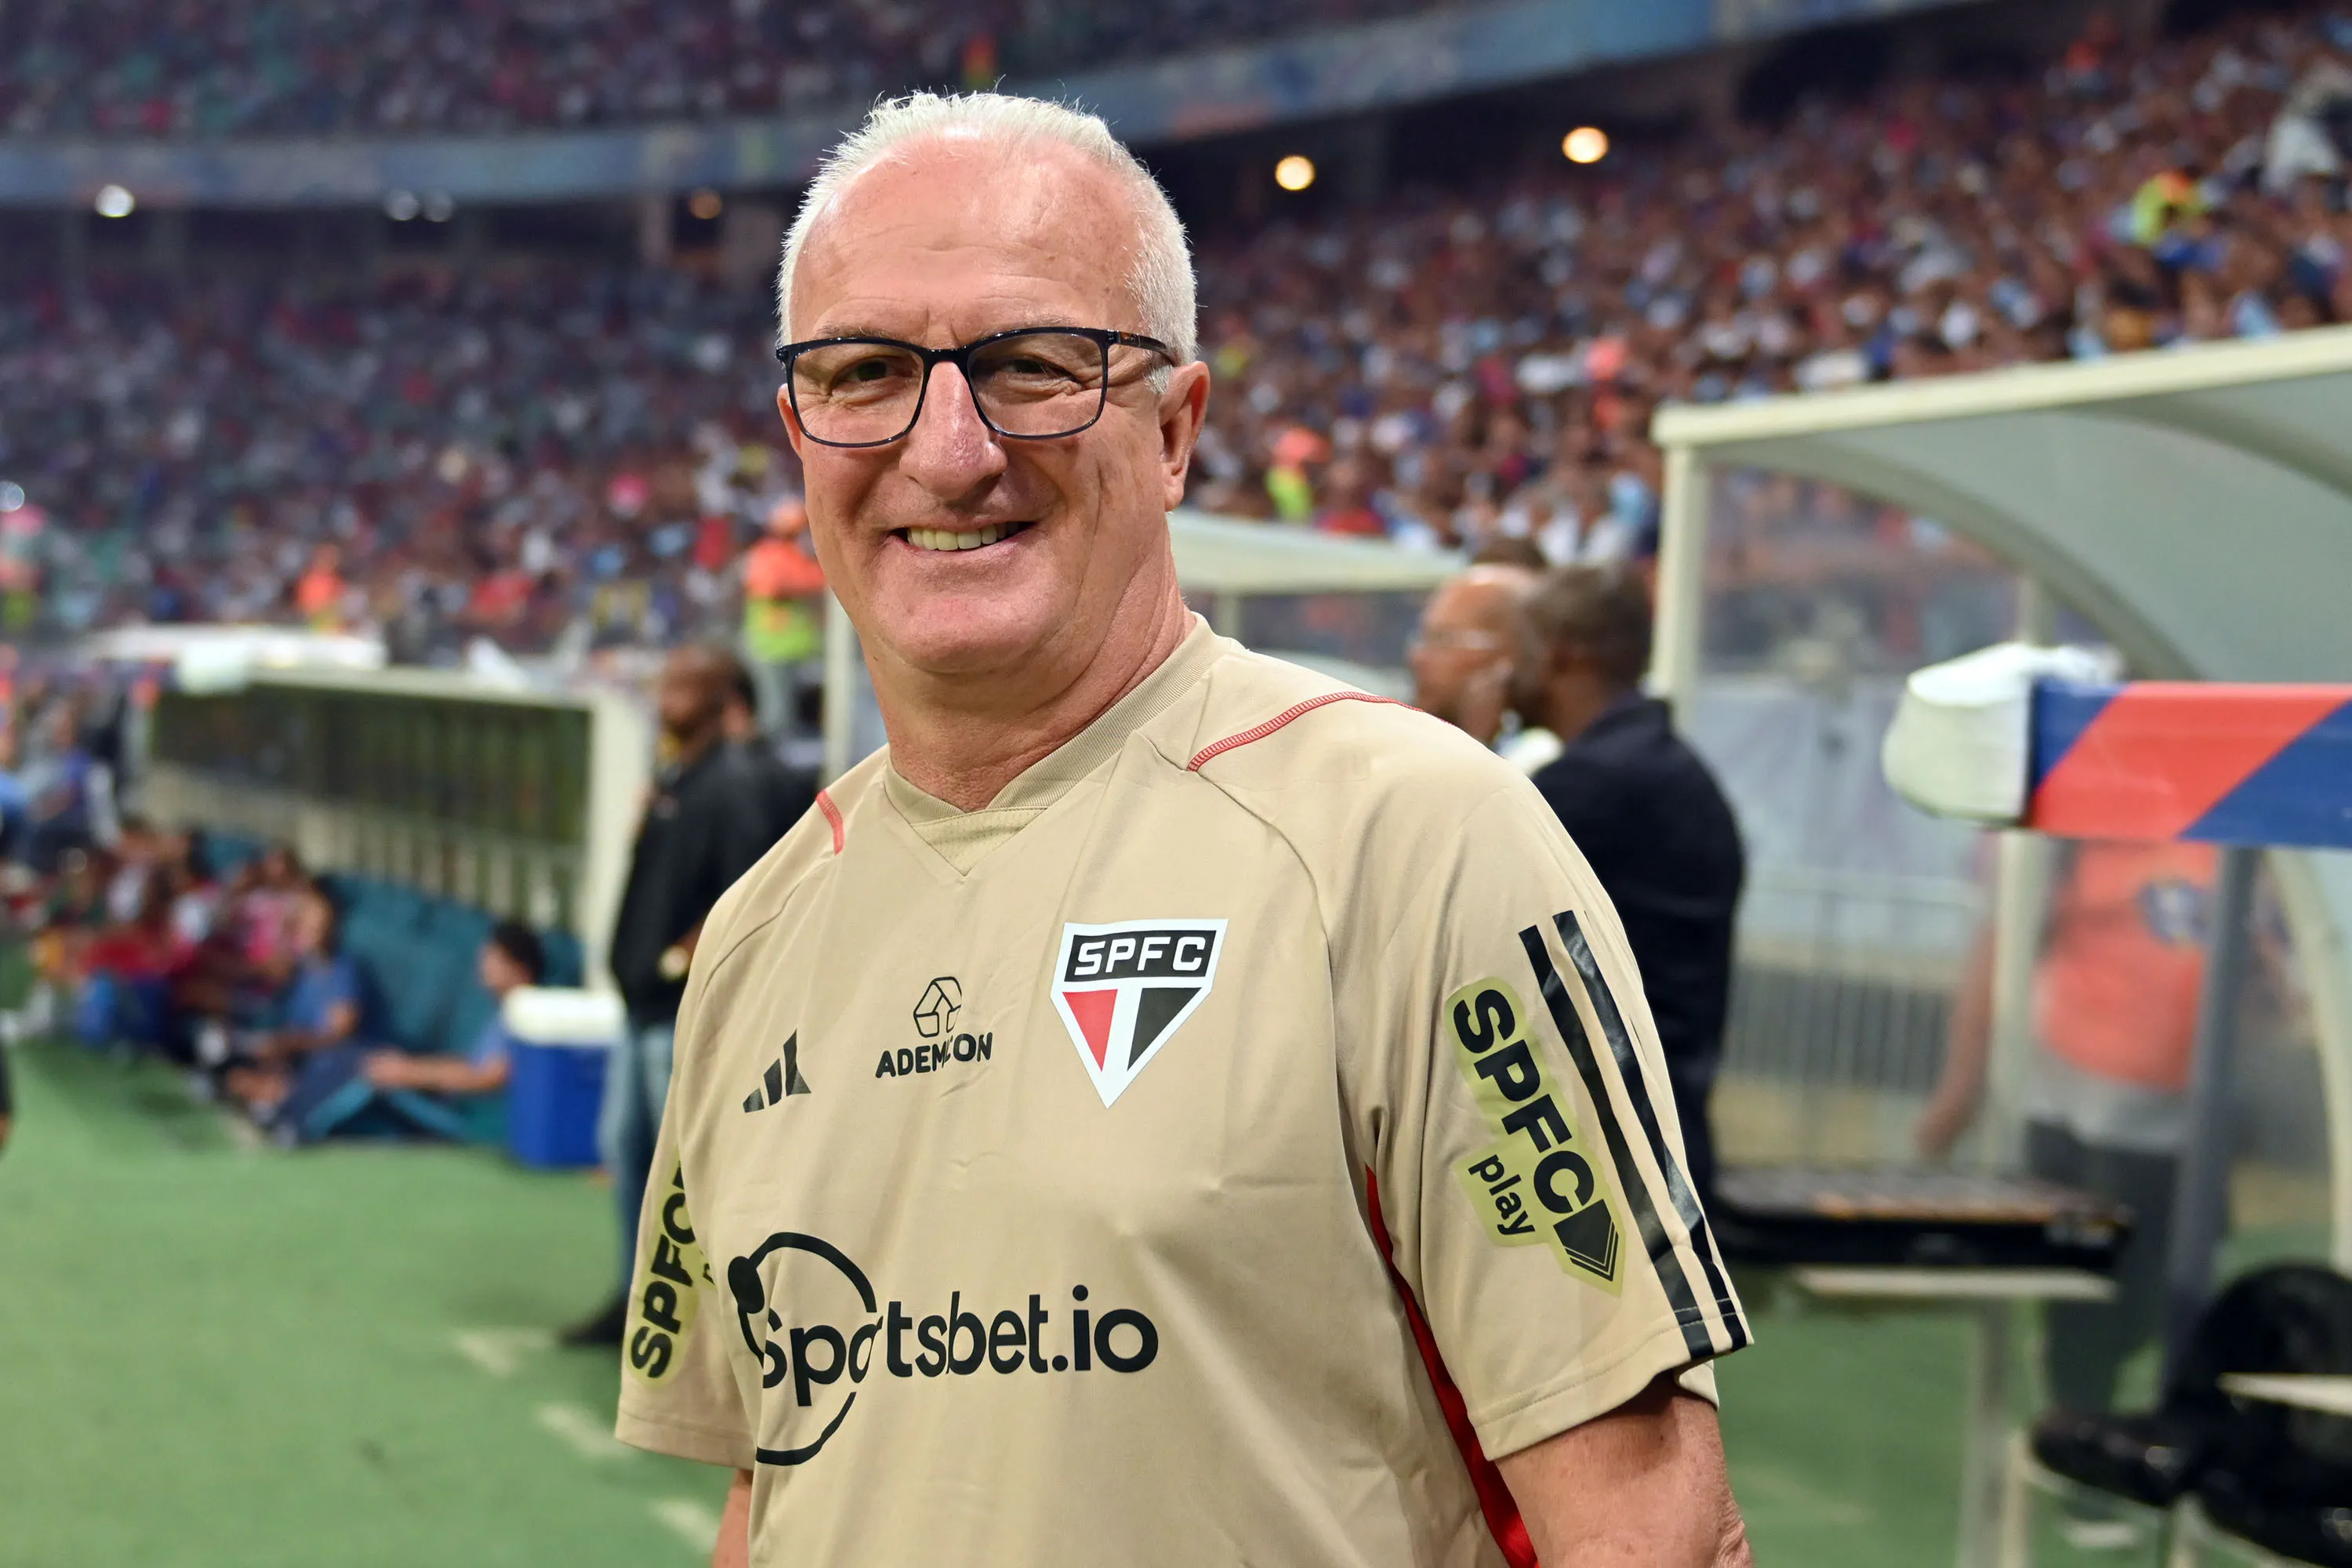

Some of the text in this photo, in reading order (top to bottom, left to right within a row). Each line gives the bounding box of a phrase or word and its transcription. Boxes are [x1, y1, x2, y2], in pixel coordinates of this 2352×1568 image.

[1074, 936, 1206, 976] SPFC
[875, 1032, 993, 1079] ADEMON
[1453, 989, 1595, 1214] SPFC
[1468, 1154, 1536, 1236] play
[631, 1192, 696, 1379] SPFC
[762, 1284, 1159, 1407] Spotsbet.io
